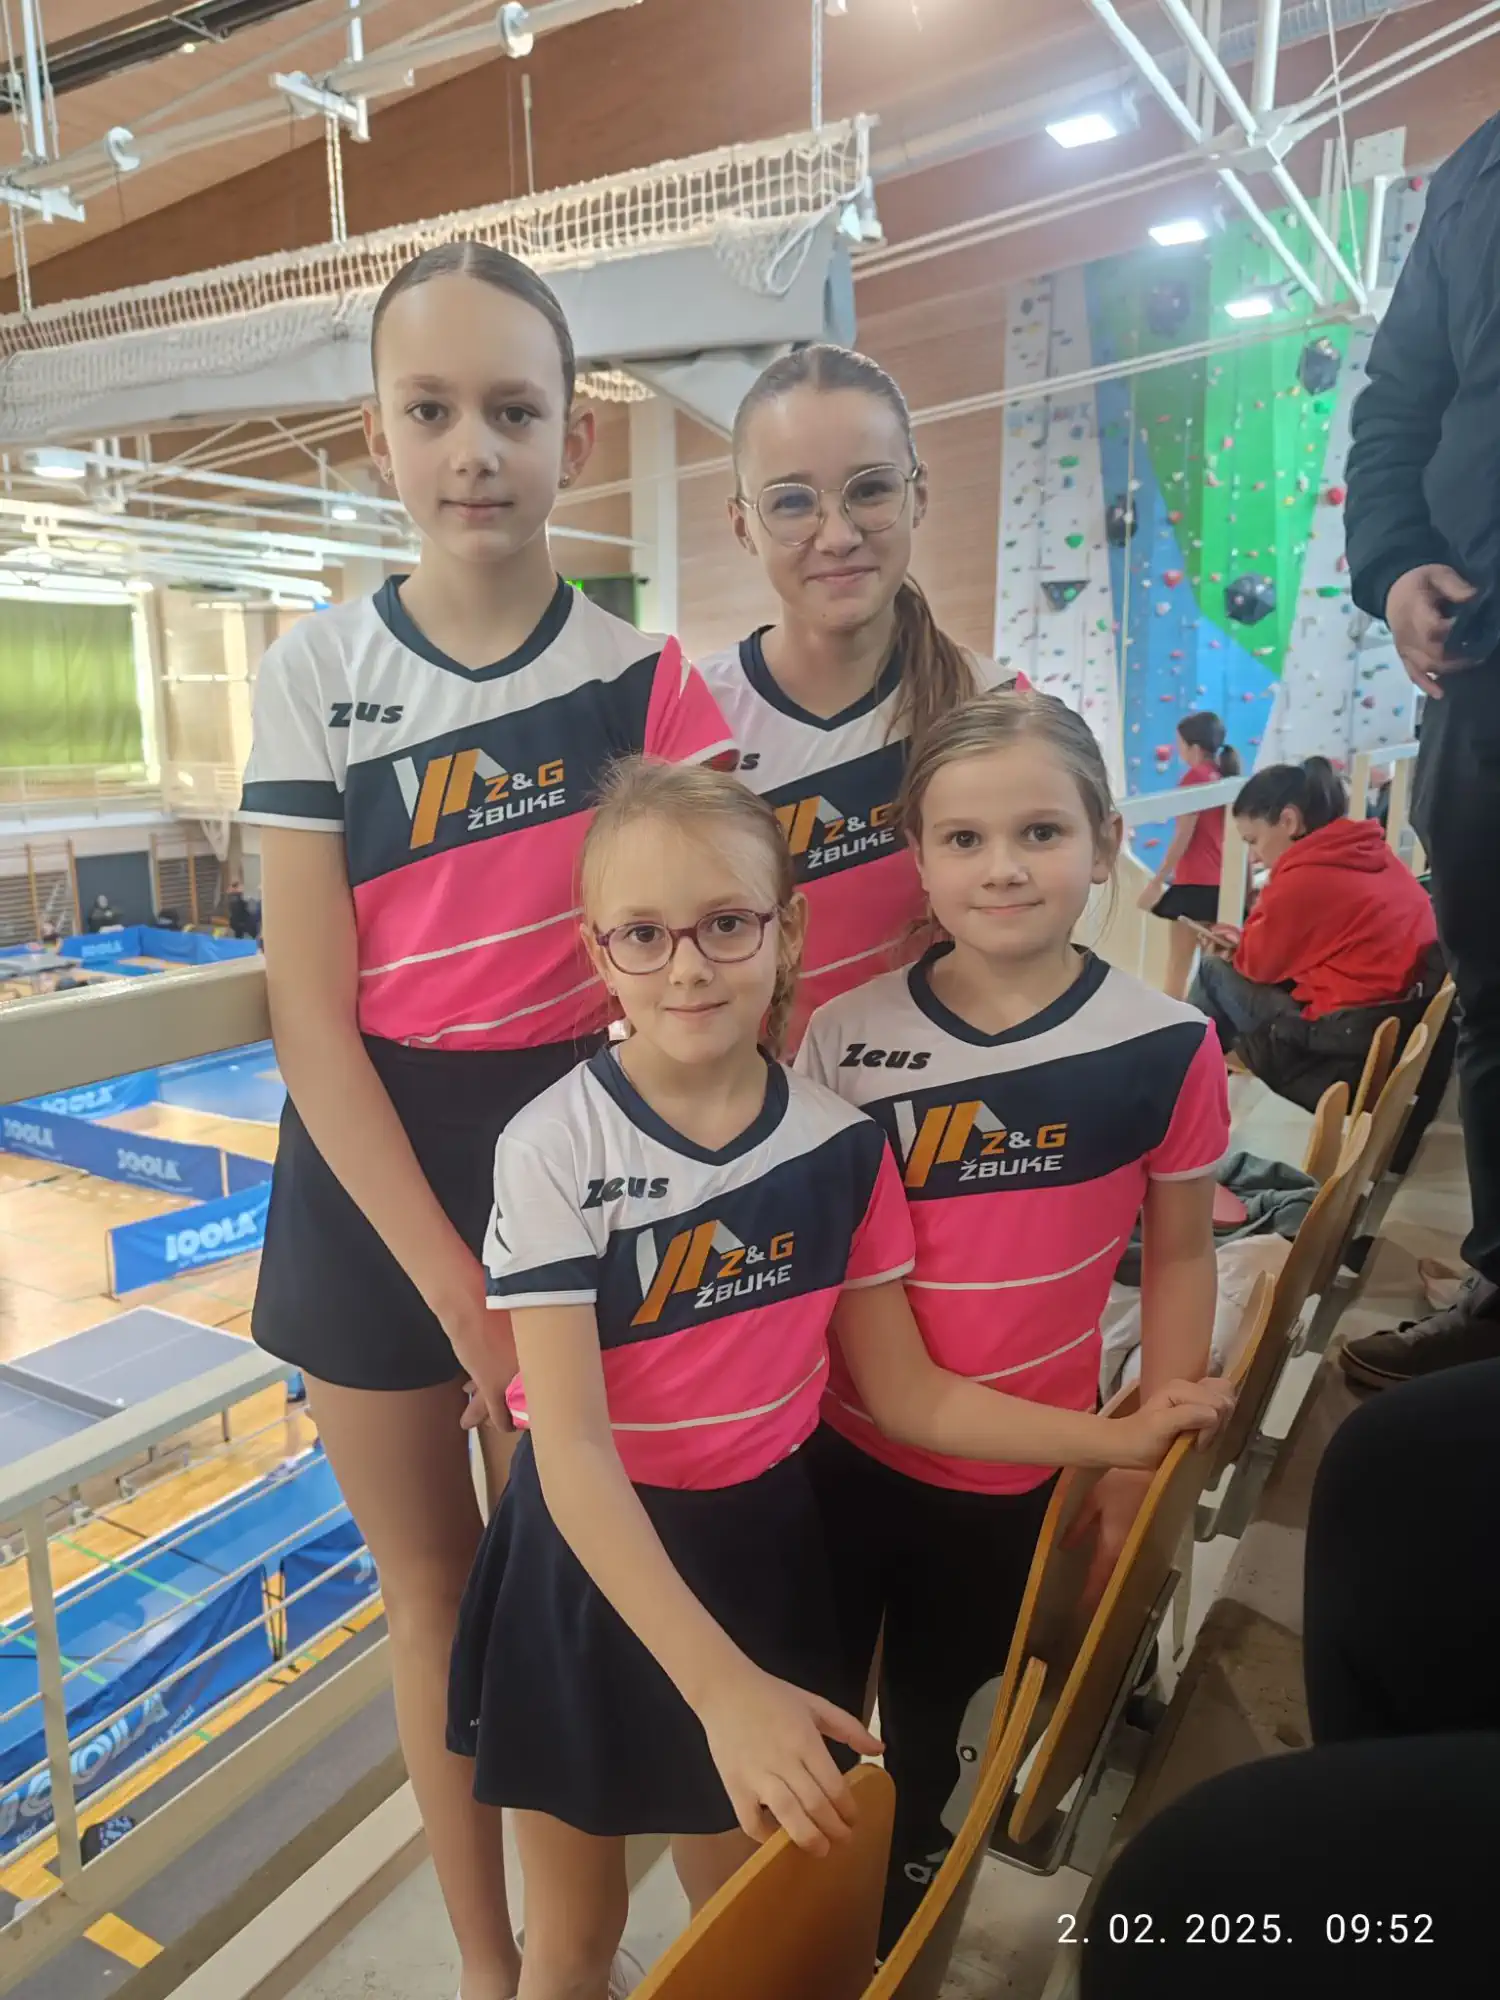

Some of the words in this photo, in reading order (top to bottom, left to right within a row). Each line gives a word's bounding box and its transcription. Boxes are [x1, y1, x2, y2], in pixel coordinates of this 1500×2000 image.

[328, 701, 404, 728] Zus
[484, 758, 565, 804] Z&G
[467, 788, 566, 831] ŽBUKE
[807, 826, 896, 869] ŽBUKE
[838, 1043, 932, 1070] Zeus
[980, 1123, 1068, 1157] Z&G
[958, 1154, 1064, 1182] ŽBUKE
[580, 1176, 670, 1210] Zeus
[716, 1231, 795, 1279] Z&G
[694, 1263, 793, 1310] ŽBUKE
